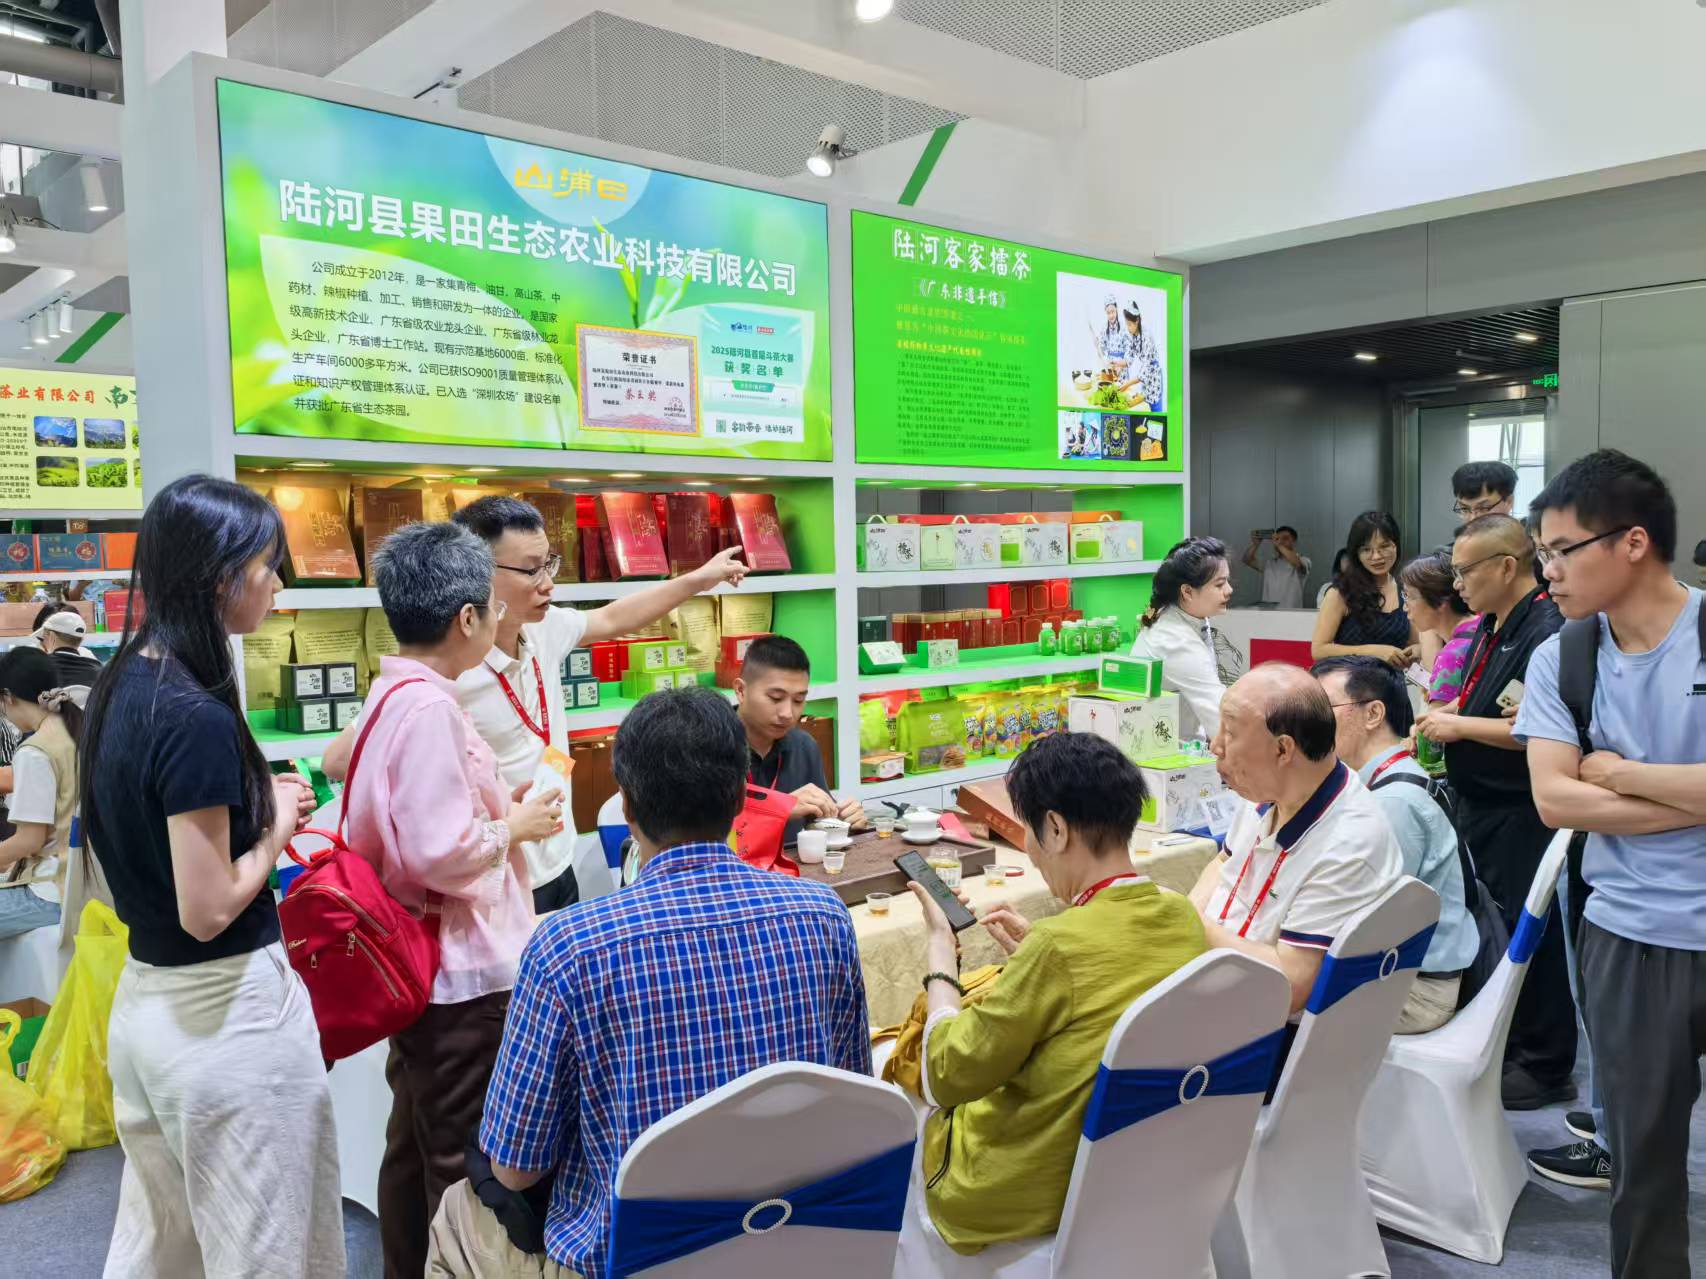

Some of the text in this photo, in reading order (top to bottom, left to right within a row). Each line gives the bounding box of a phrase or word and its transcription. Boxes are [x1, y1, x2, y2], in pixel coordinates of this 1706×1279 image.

[279, 179, 797, 296] 陆河县果田生态农业科技有限公司
[894, 228, 1031, 281] 陆河客家擂茶
[622, 352, 657, 364] 荣誉证书
[724, 360, 785, 378] 获奖名单
[0, 384, 95, 404] 茶业有限公司
